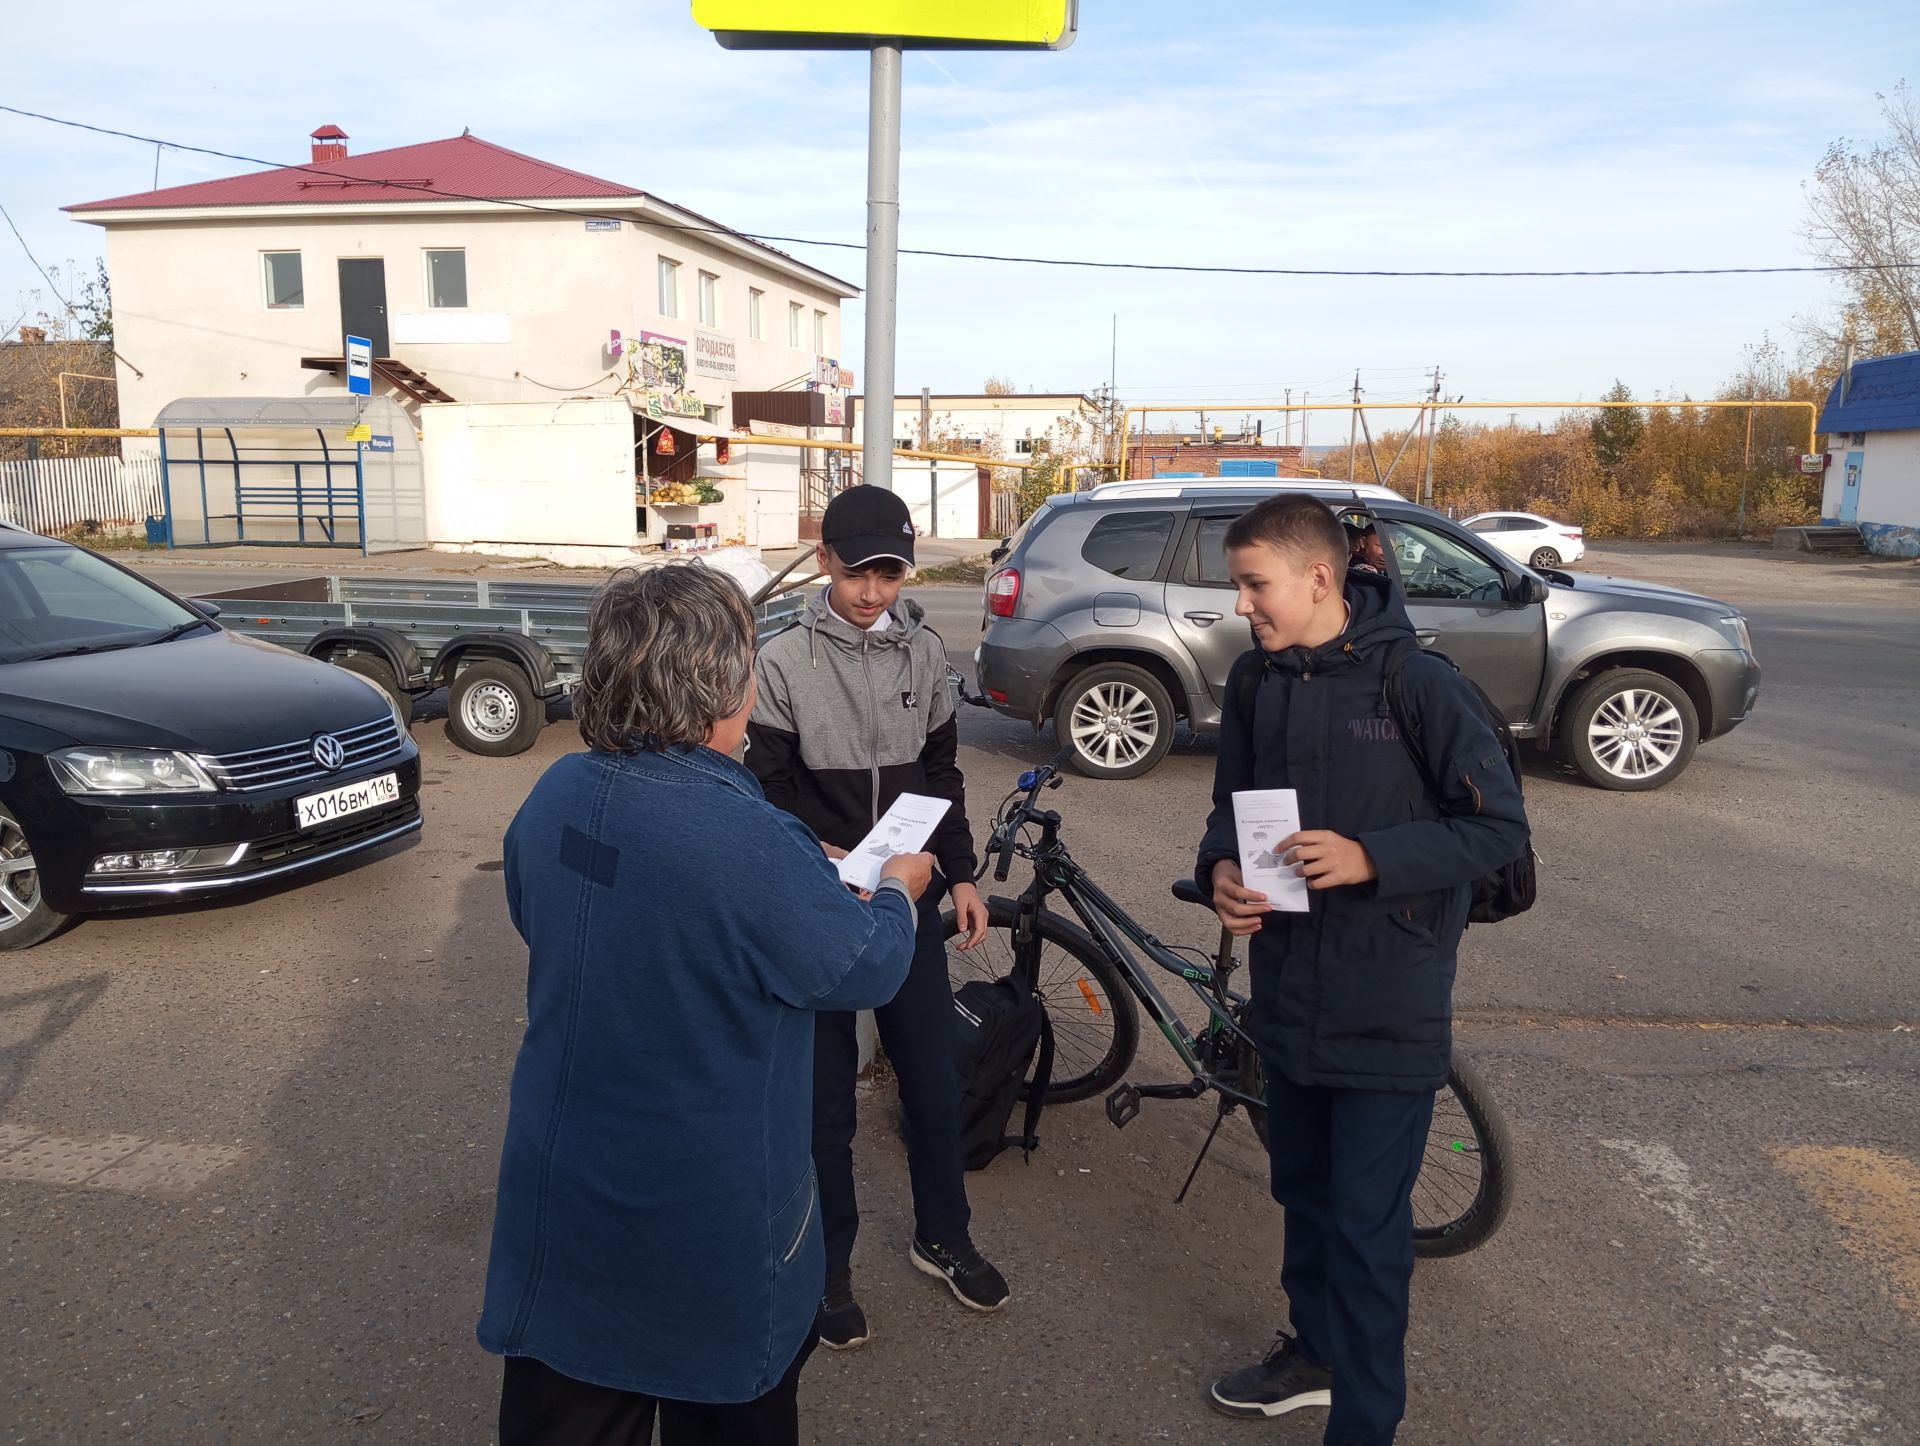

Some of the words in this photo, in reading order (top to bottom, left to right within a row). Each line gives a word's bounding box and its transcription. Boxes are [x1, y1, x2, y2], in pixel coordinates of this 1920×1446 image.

[696, 336, 736, 359] ПРОДАЕТСЯ
[305, 790, 370, 822] Х016ВМ
[371, 777, 393, 796] 116
